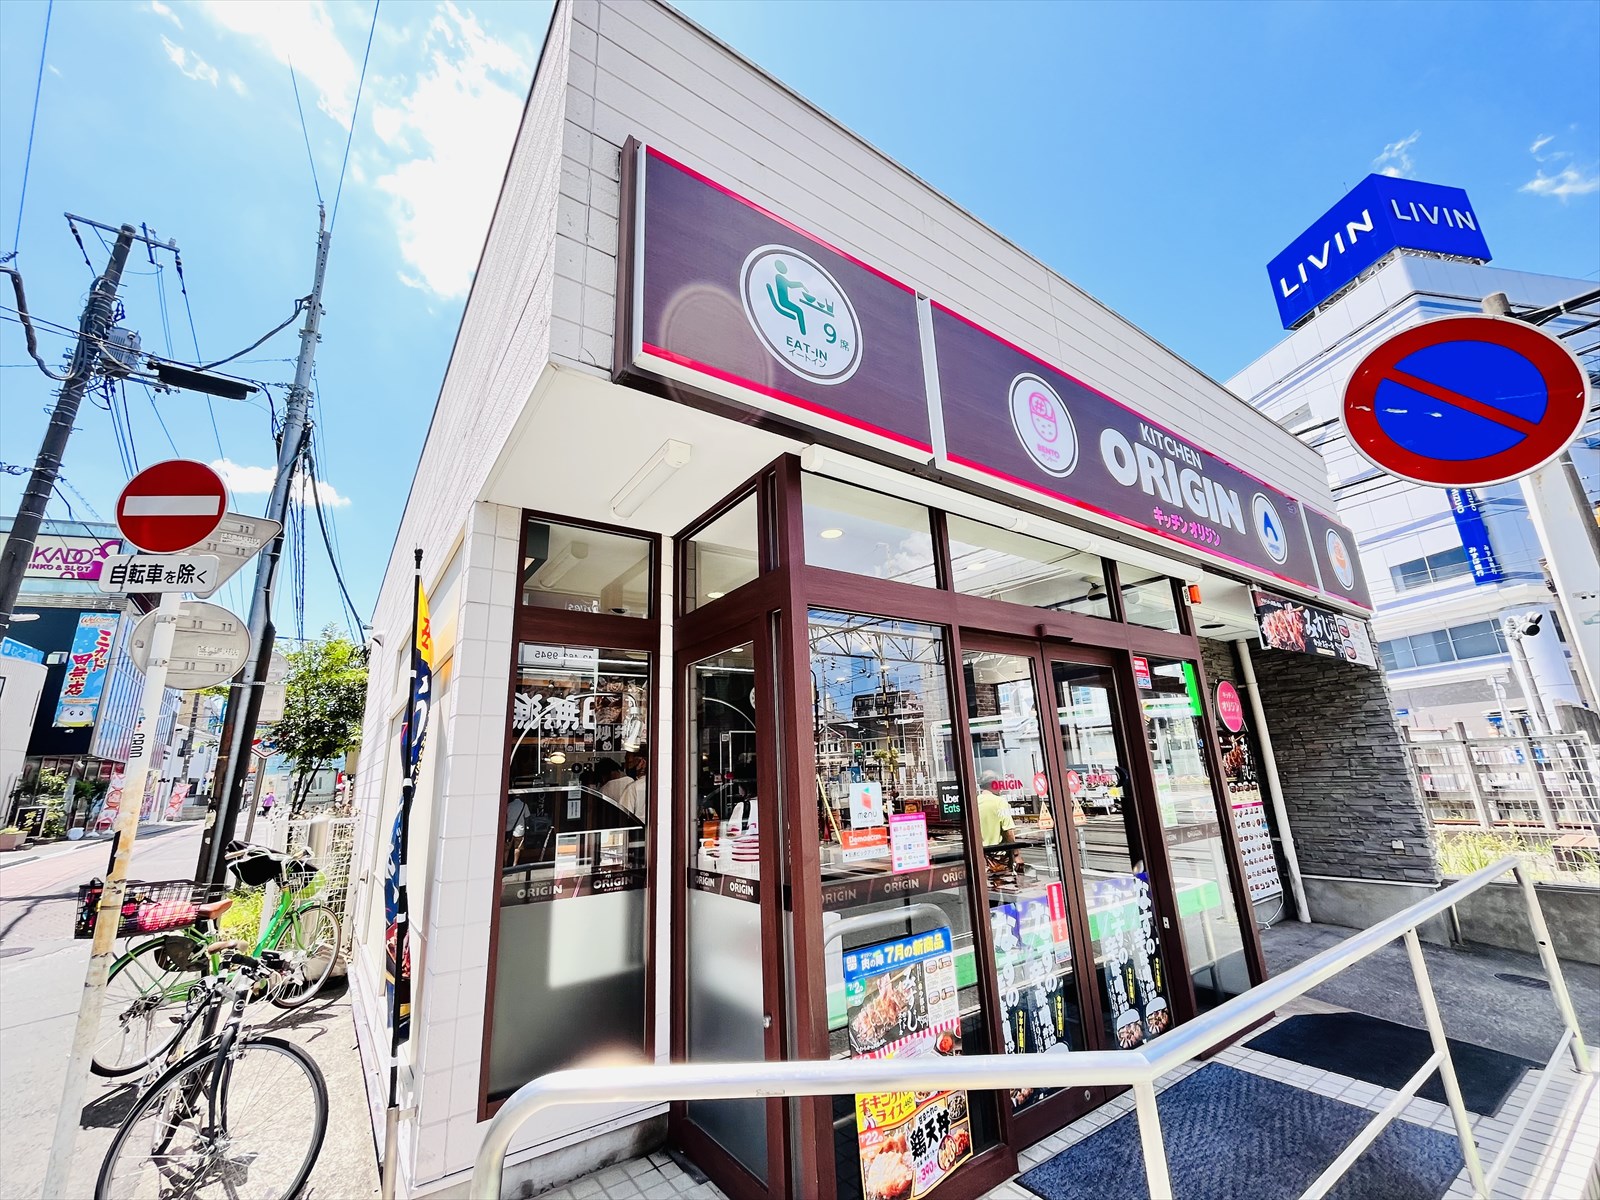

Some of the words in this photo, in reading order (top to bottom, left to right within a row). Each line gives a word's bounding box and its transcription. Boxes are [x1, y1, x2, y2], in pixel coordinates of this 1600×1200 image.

[1391, 199, 1476, 232] LIVIN
[1280, 209, 1374, 298] LIVIN
[823, 323, 837, 344] 9
[786, 335, 828, 361] EAT-IN
[789, 348, 827, 368] イートイン
[1139, 422, 1203, 470] KITCHEN
[1100, 428, 1247, 535] ORIGIN
[1153, 506, 1188, 534] キッチン
[1189, 521, 1222, 547] オリジン
[64, 565, 91, 573] SLOT
[109, 563, 208, 585] 自転車を除く
[92, 629, 112, 672] ミカド
[64, 653, 94, 696] 田無店
[942, 794, 960, 804] Uber
[943, 804, 961, 813] Eats
[857, 811, 878, 819] menu
[593, 875, 634, 890] ORIGIN
[884, 878, 919, 893] ORIGIN
[942, 870, 966, 884] ORIGI
[517, 884, 563, 899] ORIGIN
[729, 881, 754, 896] ORIGIN
[876, 1103, 904, 1124] ライス
